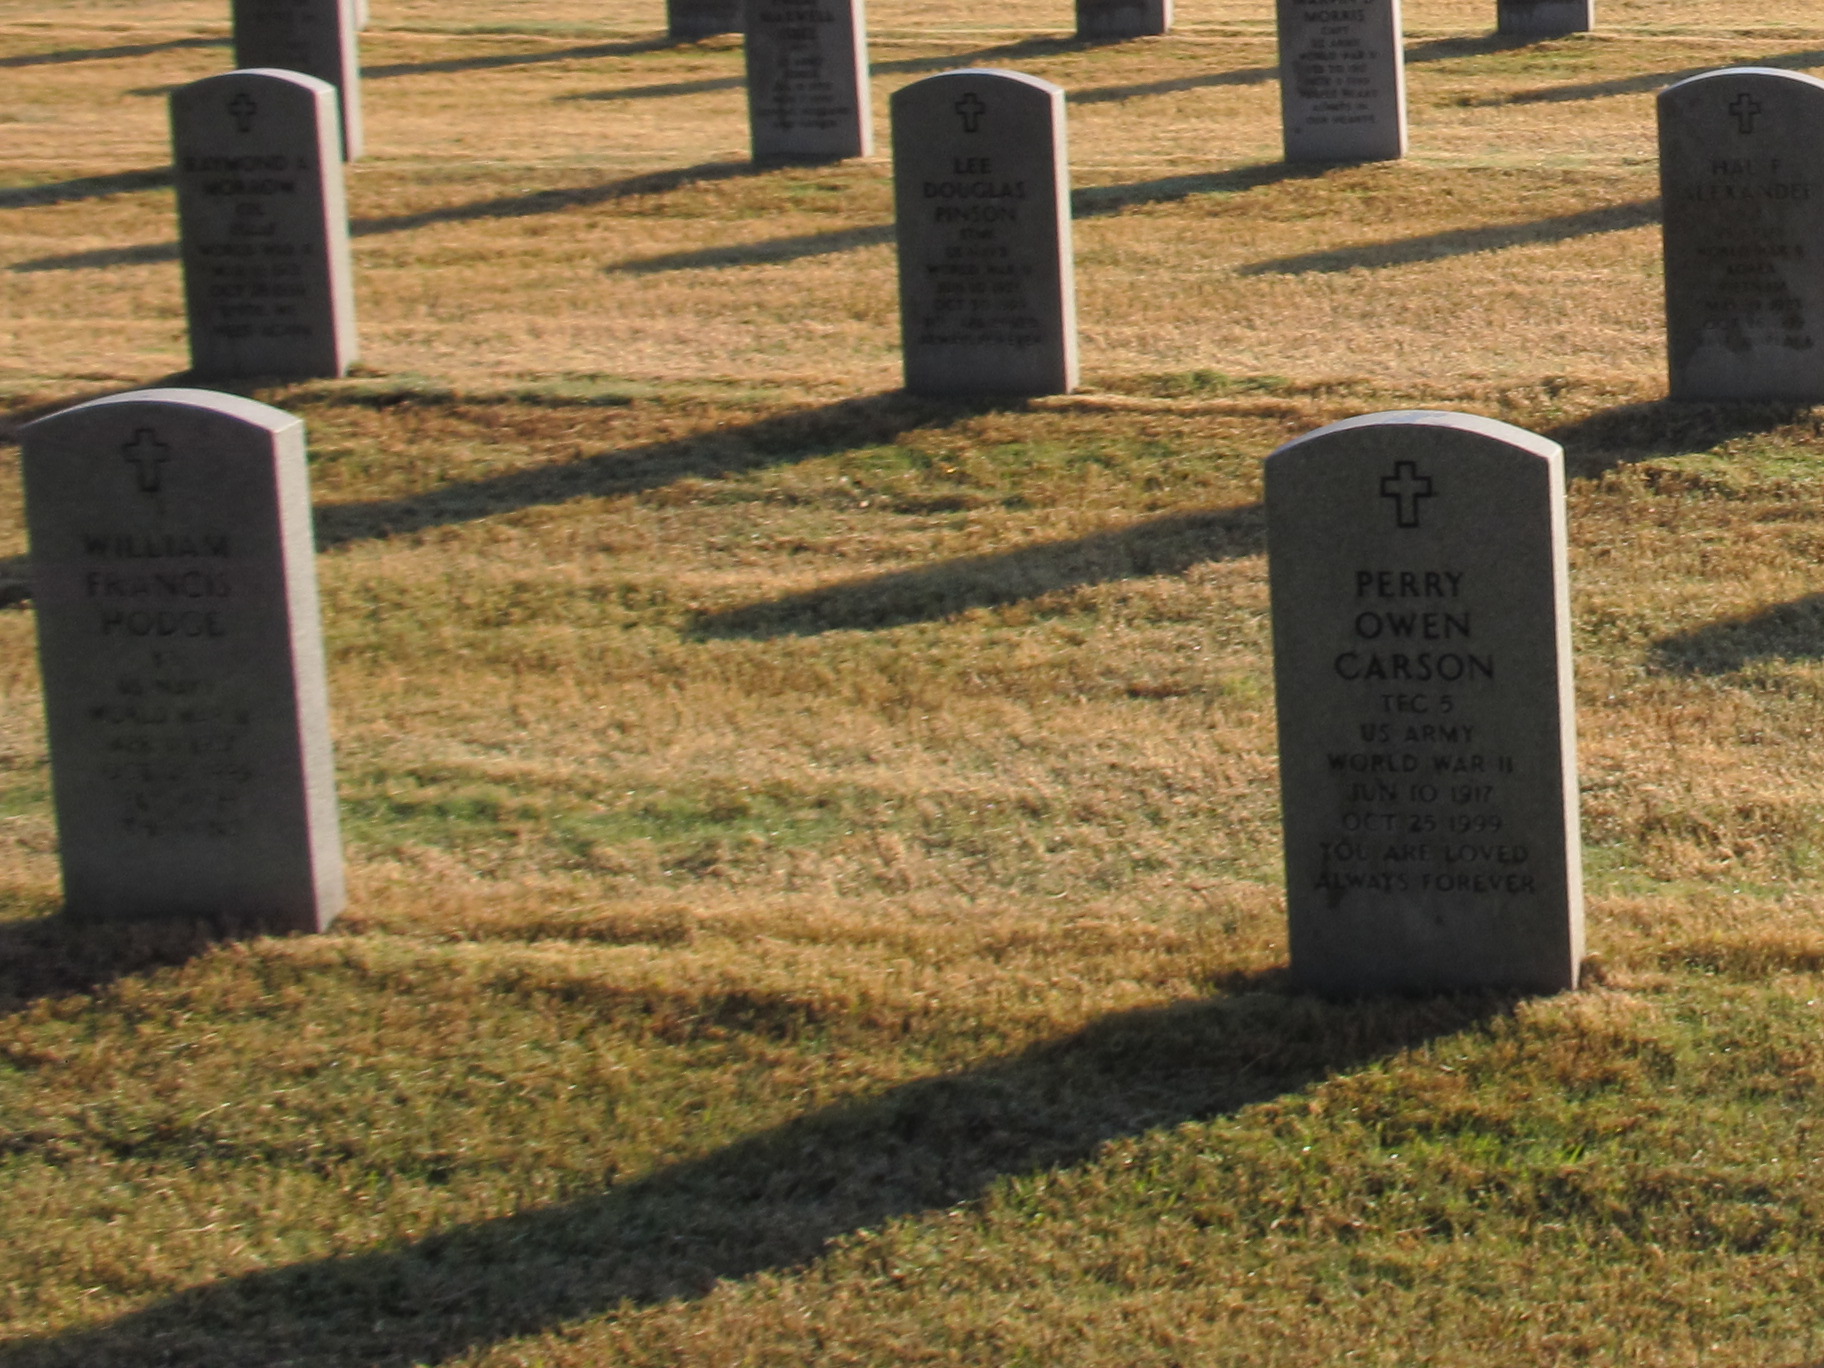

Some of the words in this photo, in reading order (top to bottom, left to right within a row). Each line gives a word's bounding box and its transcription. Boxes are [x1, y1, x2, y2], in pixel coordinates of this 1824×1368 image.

[1304, 10, 1364, 22] MORRIS
[953, 157, 992, 175] LEE
[1711, 159, 1757, 176] HAL
[923, 181, 1027, 200] DOUGLAS
[1683, 182, 1817, 202] ALEXANDER
[82, 533, 230, 558] WILLIAM
[86, 571, 232, 597] FRANCIS
[1355, 570, 1464, 598] PERRY
[100, 609, 227, 638] HODGE
[1355, 611, 1471, 640] OWEN
[1333, 651, 1495, 681] CARSON
[1440, 694, 1455, 714] 5
[1360, 723, 1390, 743] US
[1404, 723, 1474, 743] ARMY
[1326, 753, 1418, 774] WORLD
[1432, 753, 1485, 774] WAR
[1498, 754, 1514, 774] II
[1347, 782, 1397, 803] JUN
[1410, 784, 1438, 803] 10
[1450, 784, 1494, 805] 1917
[1341, 812, 1397, 832] OCT
[1408, 814, 1438, 834] 25
[1449, 814, 1503, 834] 1999
[1318, 840, 1367, 863] YOU
[1383, 843, 1430, 863] ARE
[1444, 844, 1529, 866] LOVED
[1313, 871, 1409, 893] ALWAYS
[1421, 872, 1537, 895] FOREVER
